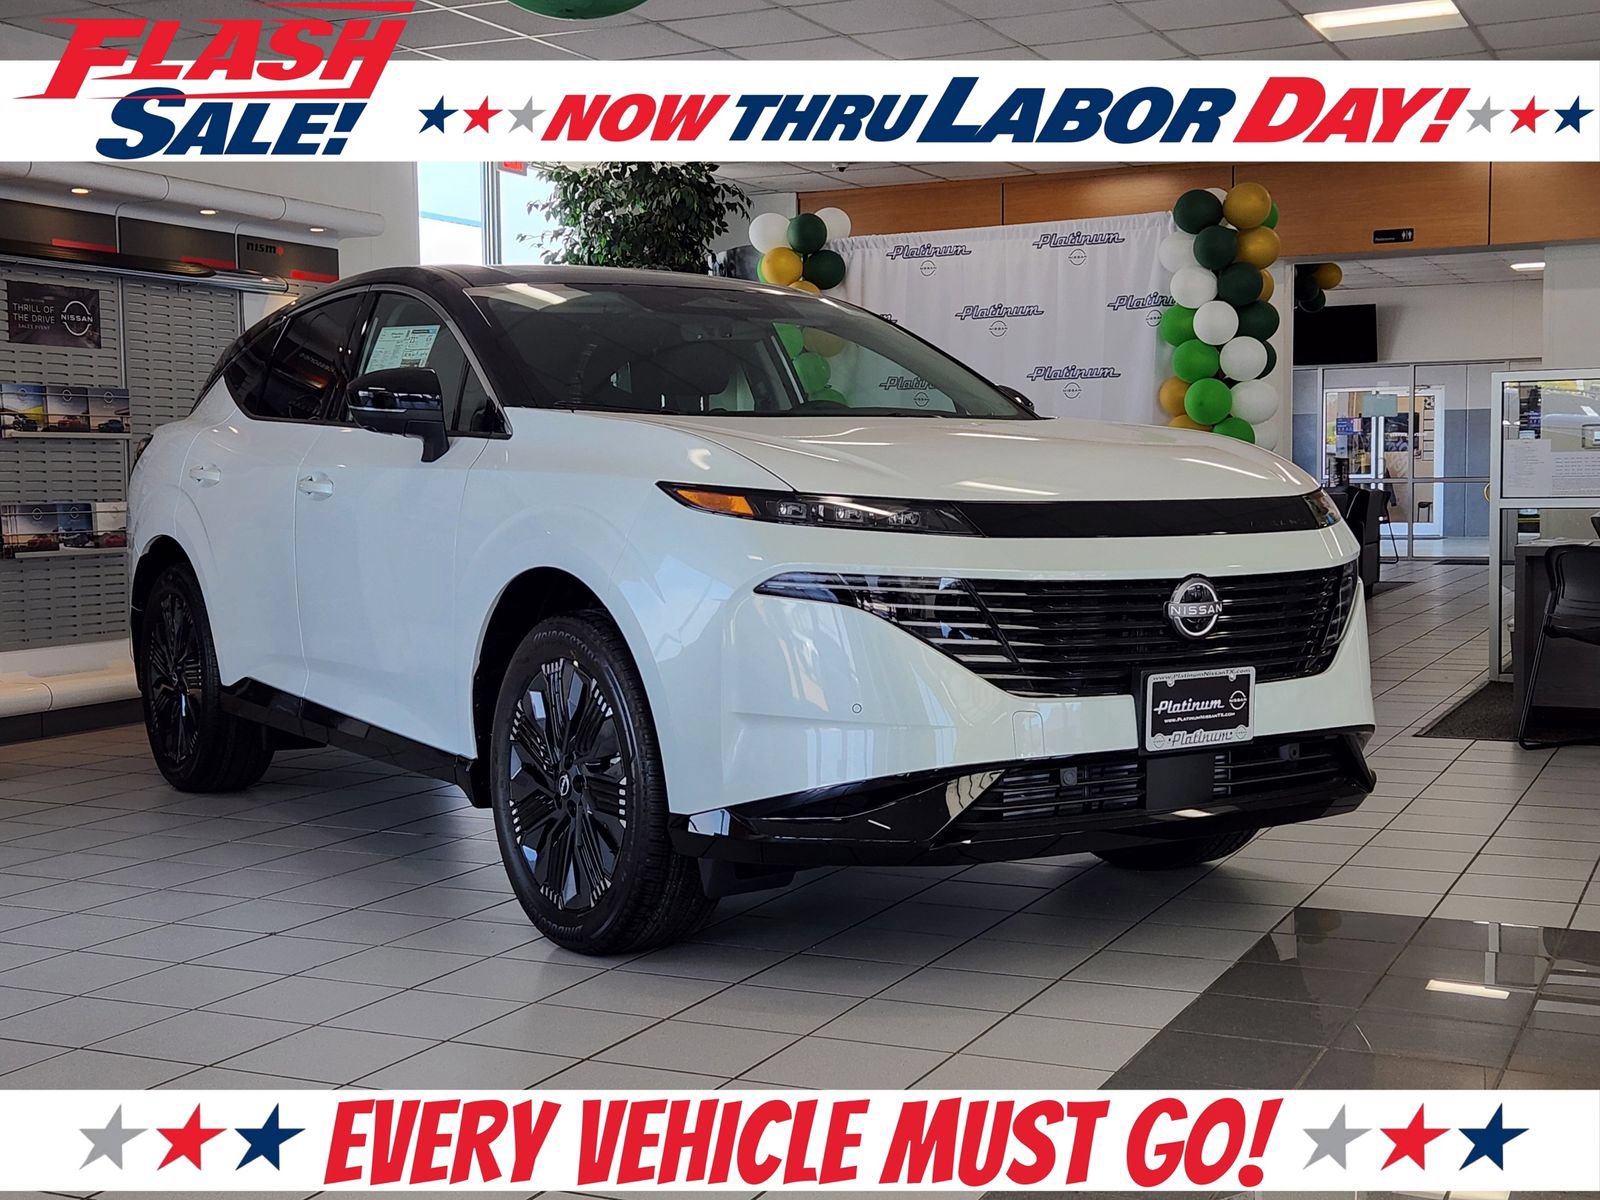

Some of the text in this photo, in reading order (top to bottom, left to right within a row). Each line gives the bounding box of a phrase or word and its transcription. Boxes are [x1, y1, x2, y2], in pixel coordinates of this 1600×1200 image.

[1032, 231, 1126, 249] Platinum
[886, 243, 972, 260] Platinum
[12, 302, 55, 314] THRILL OF
[1107, 291, 1176, 311] Platin
[12, 312, 55, 324] THE DRIVE
[61, 314, 93, 323] NISSAN
[954, 302, 1045, 320] Platinum
[1026, 364, 1122, 381] Platinum
[879, 376, 935, 391] Platin
[1170, 603, 1222, 616] NISSAN
[1153, 697, 1225, 715] Platinum
[1171, 729, 1233, 746] Platinum
